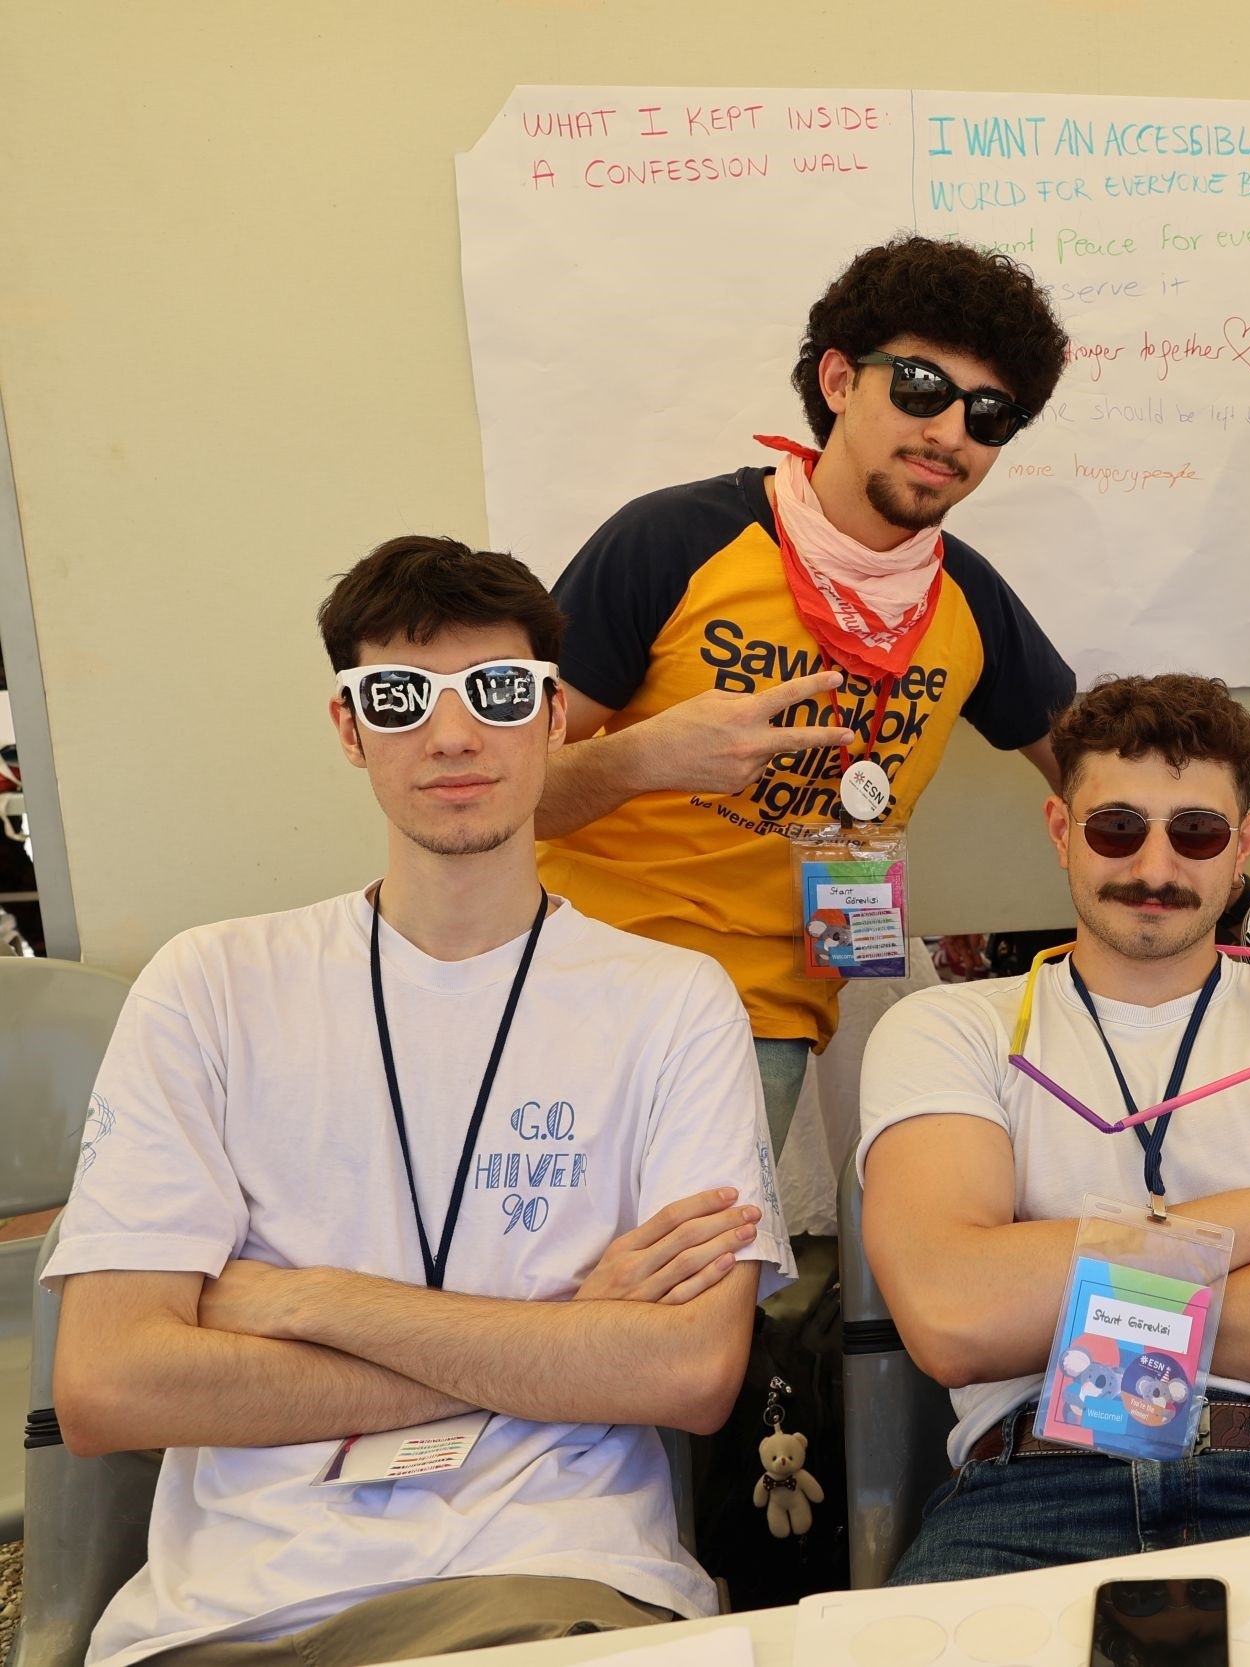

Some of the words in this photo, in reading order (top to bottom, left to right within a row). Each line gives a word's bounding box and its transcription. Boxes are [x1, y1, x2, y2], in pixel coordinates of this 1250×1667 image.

[522, 109, 617, 140] WHAT
[638, 107, 669, 136] I
[686, 105, 764, 137] KEPT
[928, 117, 956, 156] I
[963, 116, 1046, 159] WANT
[1054, 117, 1095, 156] AN
[531, 158, 555, 191] A
[584, 153, 769, 189] CONFESSION
[793, 152, 870, 175] WALL
[930, 180, 1027, 212] WORLD
[1035, 178, 1093, 203] FOR
[1104, 170, 1228, 198] EVERYONE
[1057, 228, 1138, 265] Peace
[1161, 222, 1204, 252] for
[1161, 272, 1191, 297] it
[1140, 331, 1226, 382] together
[1088, 397, 1164, 425] should
[1175, 402, 1194, 424] be
[1210, 402, 1235, 431] left
[1008, 463, 1055, 479] more
[370, 682, 430, 713] ESN
[862, 779, 885, 805] ESN
[717, 803, 755, 830] were
[501, 1193, 550, 1236] 90
[1147, 1358, 1166, 1372] ESN
[1086, 1407, 1124, 1423] Welcome!
